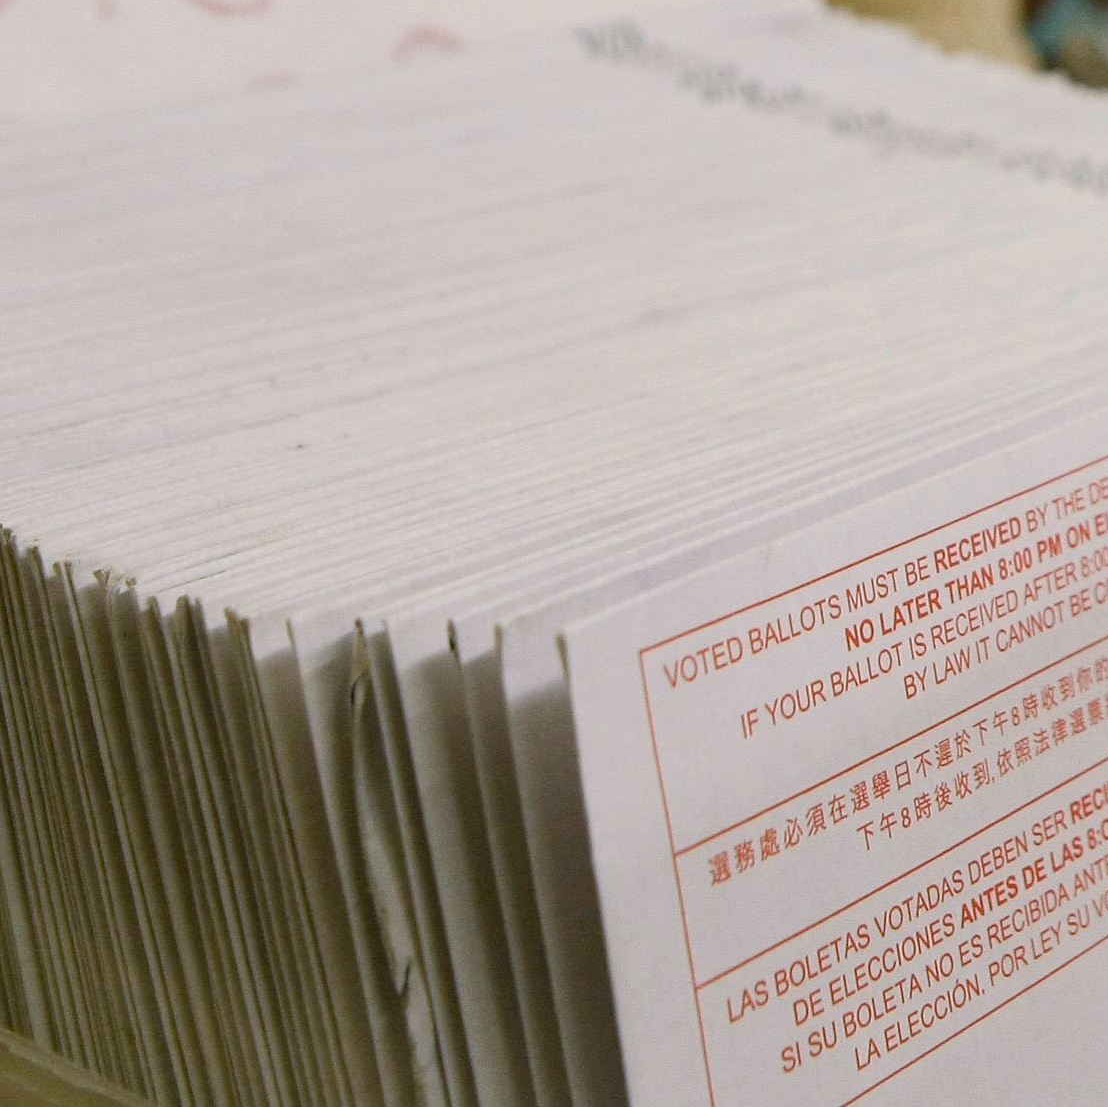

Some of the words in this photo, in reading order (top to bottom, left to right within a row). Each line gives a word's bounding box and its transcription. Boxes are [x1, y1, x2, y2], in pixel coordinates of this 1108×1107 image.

[664, 634, 745, 690] VOTED
[747, 592, 844, 656] BALLOTS
[844, 566, 899, 613] MUST
[904, 555, 932, 588] BE
[933, 515, 1023, 573] RECEIVED
[1023, 506, 1048, 534] BY
[1051, 487, 1087, 520] THE
[740, 707, 760, 739] IF
[764, 677, 828, 725] YOUR
[829, 640, 904, 699] BALLOT
[908, 631, 930, 660] IS
[930, 588, 1019, 648] RECEIVED
[1023, 560, 1079, 603] AFTER
[844, 617, 876, 651] NO
[880, 587, 943, 637] LATER
[945, 566, 996, 602] THAN
[997, 546, 1034, 582] 8:00
[1036, 532, 1063, 560] PM
[1065, 522, 1093, 549] ON
[902, 666, 929, 700] BY
[932, 647, 973, 686] LAW
[976, 635, 991, 661] IT
[995, 599, 1064, 654] CANNOT
[1069, 587, 1094, 620] BE
[726, 978, 772, 1024] LAS
[773, 922, 873, 998] BOLETAS
[874, 868, 966, 938] VOTADAS
[967, 835, 1030, 887] DEBEN
[1032, 807, 1069, 848] SER
[780, 1041, 804, 1075] SI
[807, 1021, 840, 1060] SU
[841, 972, 924, 1040] BOLETA
[924, 951, 956, 987] NO
[958, 933, 986, 968] ES
[986, 883, 1071, 947] RECIBIDA
[792, 988, 826, 1028] DE
[828, 911, 957, 1007] ELECCIONES
[960, 873, 1021, 927] ANTES
[1021, 857, 1049, 891] DE
[1050, 835, 1085, 873] LAS
[854, 1037, 883, 1073] LA
[988, 943, 1029, 985] POR
[1030, 924, 1063, 962] LEY
[1064, 906, 1092, 938] SU
